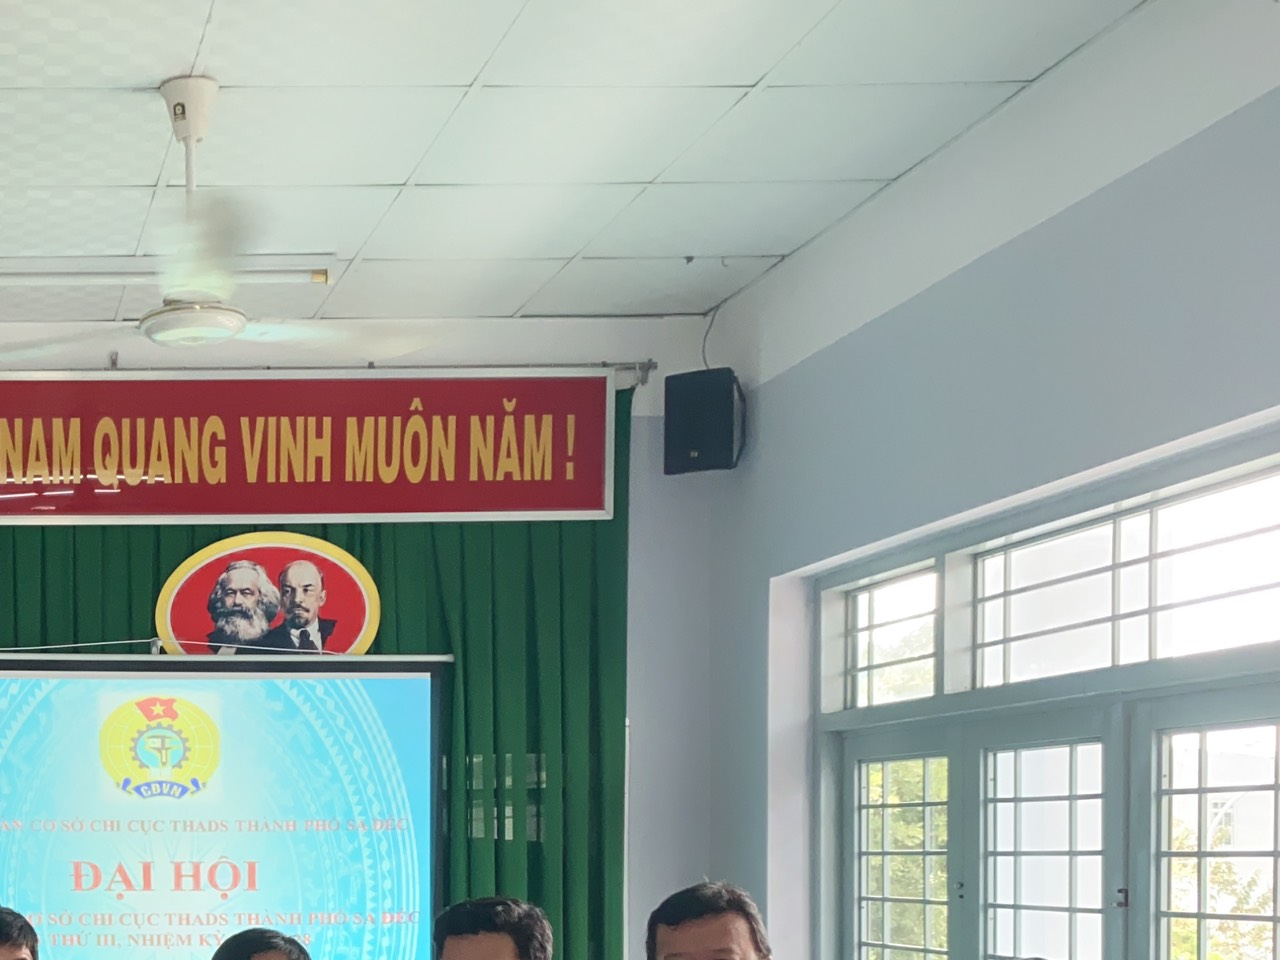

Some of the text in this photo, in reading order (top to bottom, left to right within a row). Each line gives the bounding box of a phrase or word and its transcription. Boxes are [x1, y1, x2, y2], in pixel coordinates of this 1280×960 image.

[93, 415, 227, 490] QUANG
[240, 415, 332, 484] VINH
[345, 397, 457, 484] MUÔN
[470, 397, 553, 482] NĂM
[565, 414, 575, 481] !
[89, 819, 121, 833] CHI
[127, 819, 165, 835] CỤC
[170, 819, 229, 833] THADS
[234, 815, 297, 833] THÀNH
[69, 856, 260, 900] ĐẠI HỘI
[78, 913, 114, 926] CHI
[119, 913, 160, 928] CỤC
[164, 913, 229, 926] THADS
[234, 909, 302, 926] THÀNH
[353, 912, 376, 925] SA
[48, 930, 91, 947] THỨ
[127, 931, 192, 949] NHIỆM
